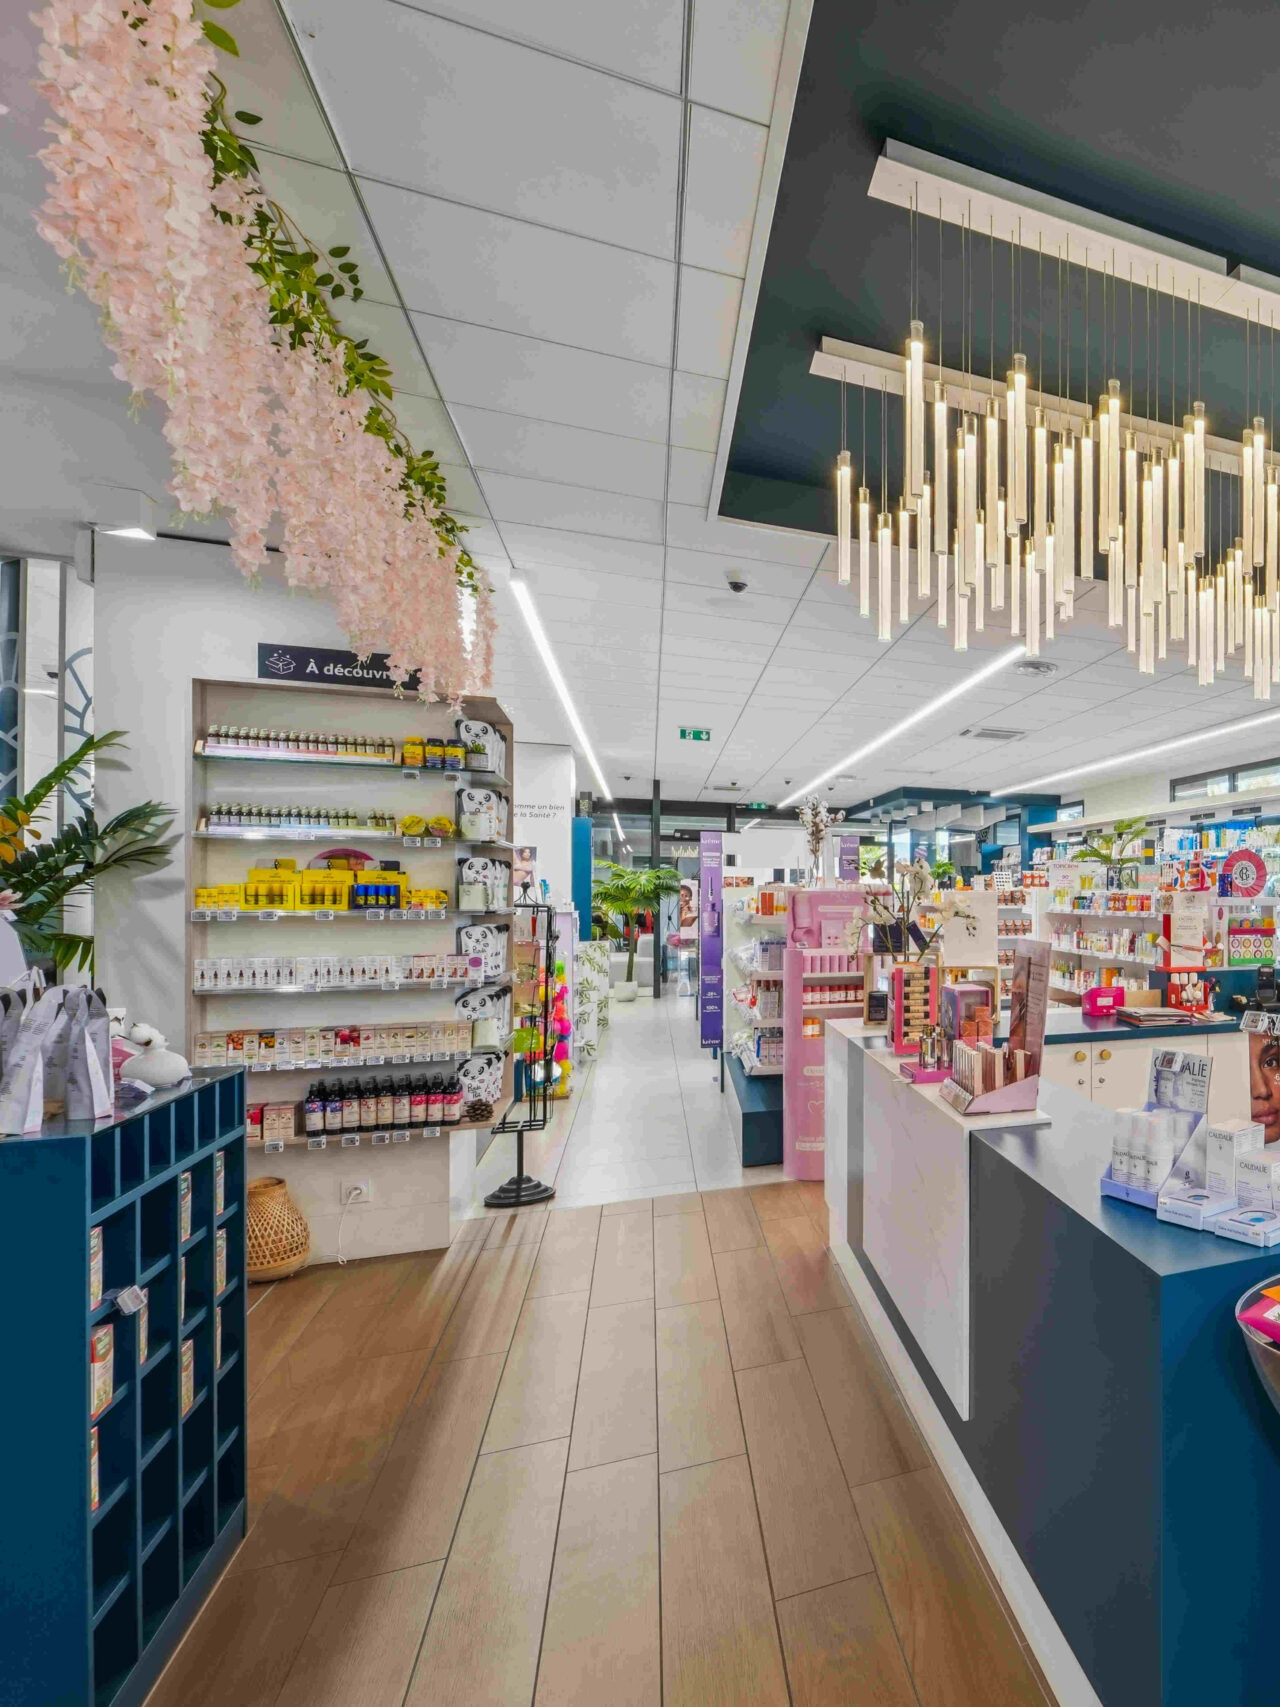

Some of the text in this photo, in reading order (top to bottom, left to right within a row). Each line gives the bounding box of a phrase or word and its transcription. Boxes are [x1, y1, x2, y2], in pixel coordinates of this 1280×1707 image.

[305, 659, 388, 680] À découvr
[529, 811, 551, 819] Santé
